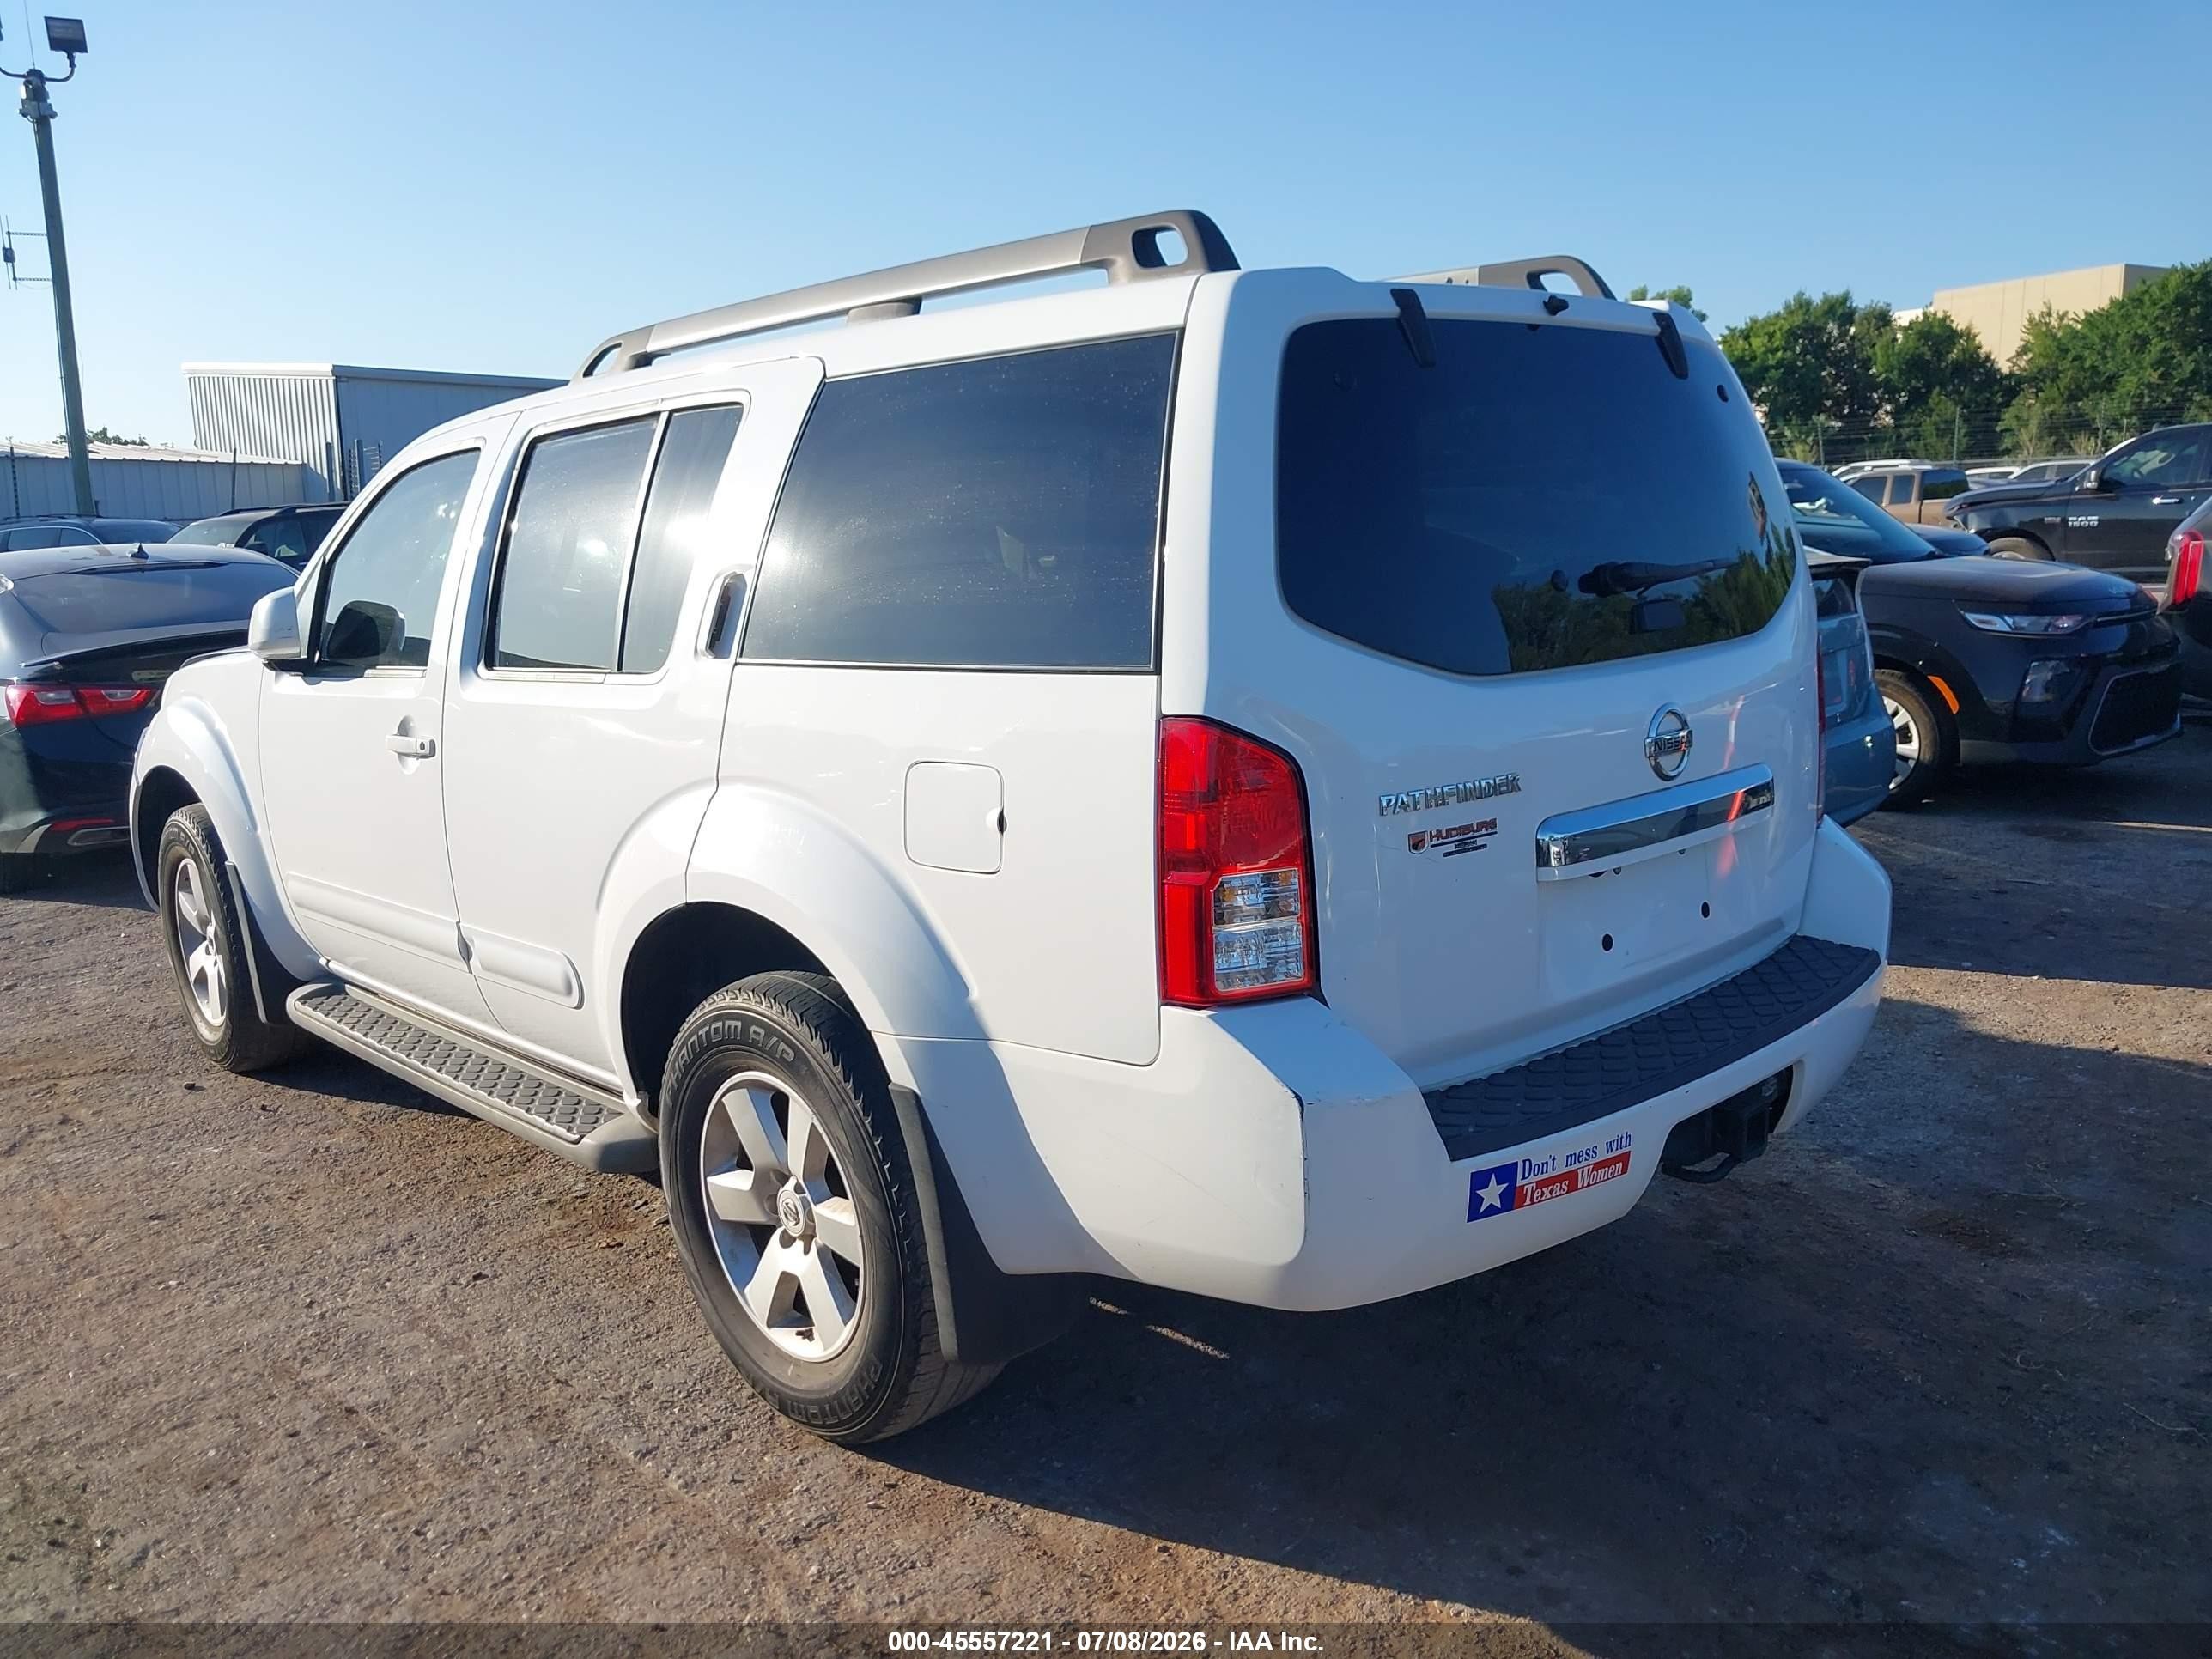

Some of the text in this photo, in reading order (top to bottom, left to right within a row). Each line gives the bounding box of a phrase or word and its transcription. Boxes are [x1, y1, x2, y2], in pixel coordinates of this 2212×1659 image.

[1379, 772, 1522, 816] PATHFINDER
[666, 1019, 795, 1109] PHANTOM A/P
[1521, 1131, 1632, 1181] Don't mess with
[1523, 1162, 1623, 1206] Texas Women
